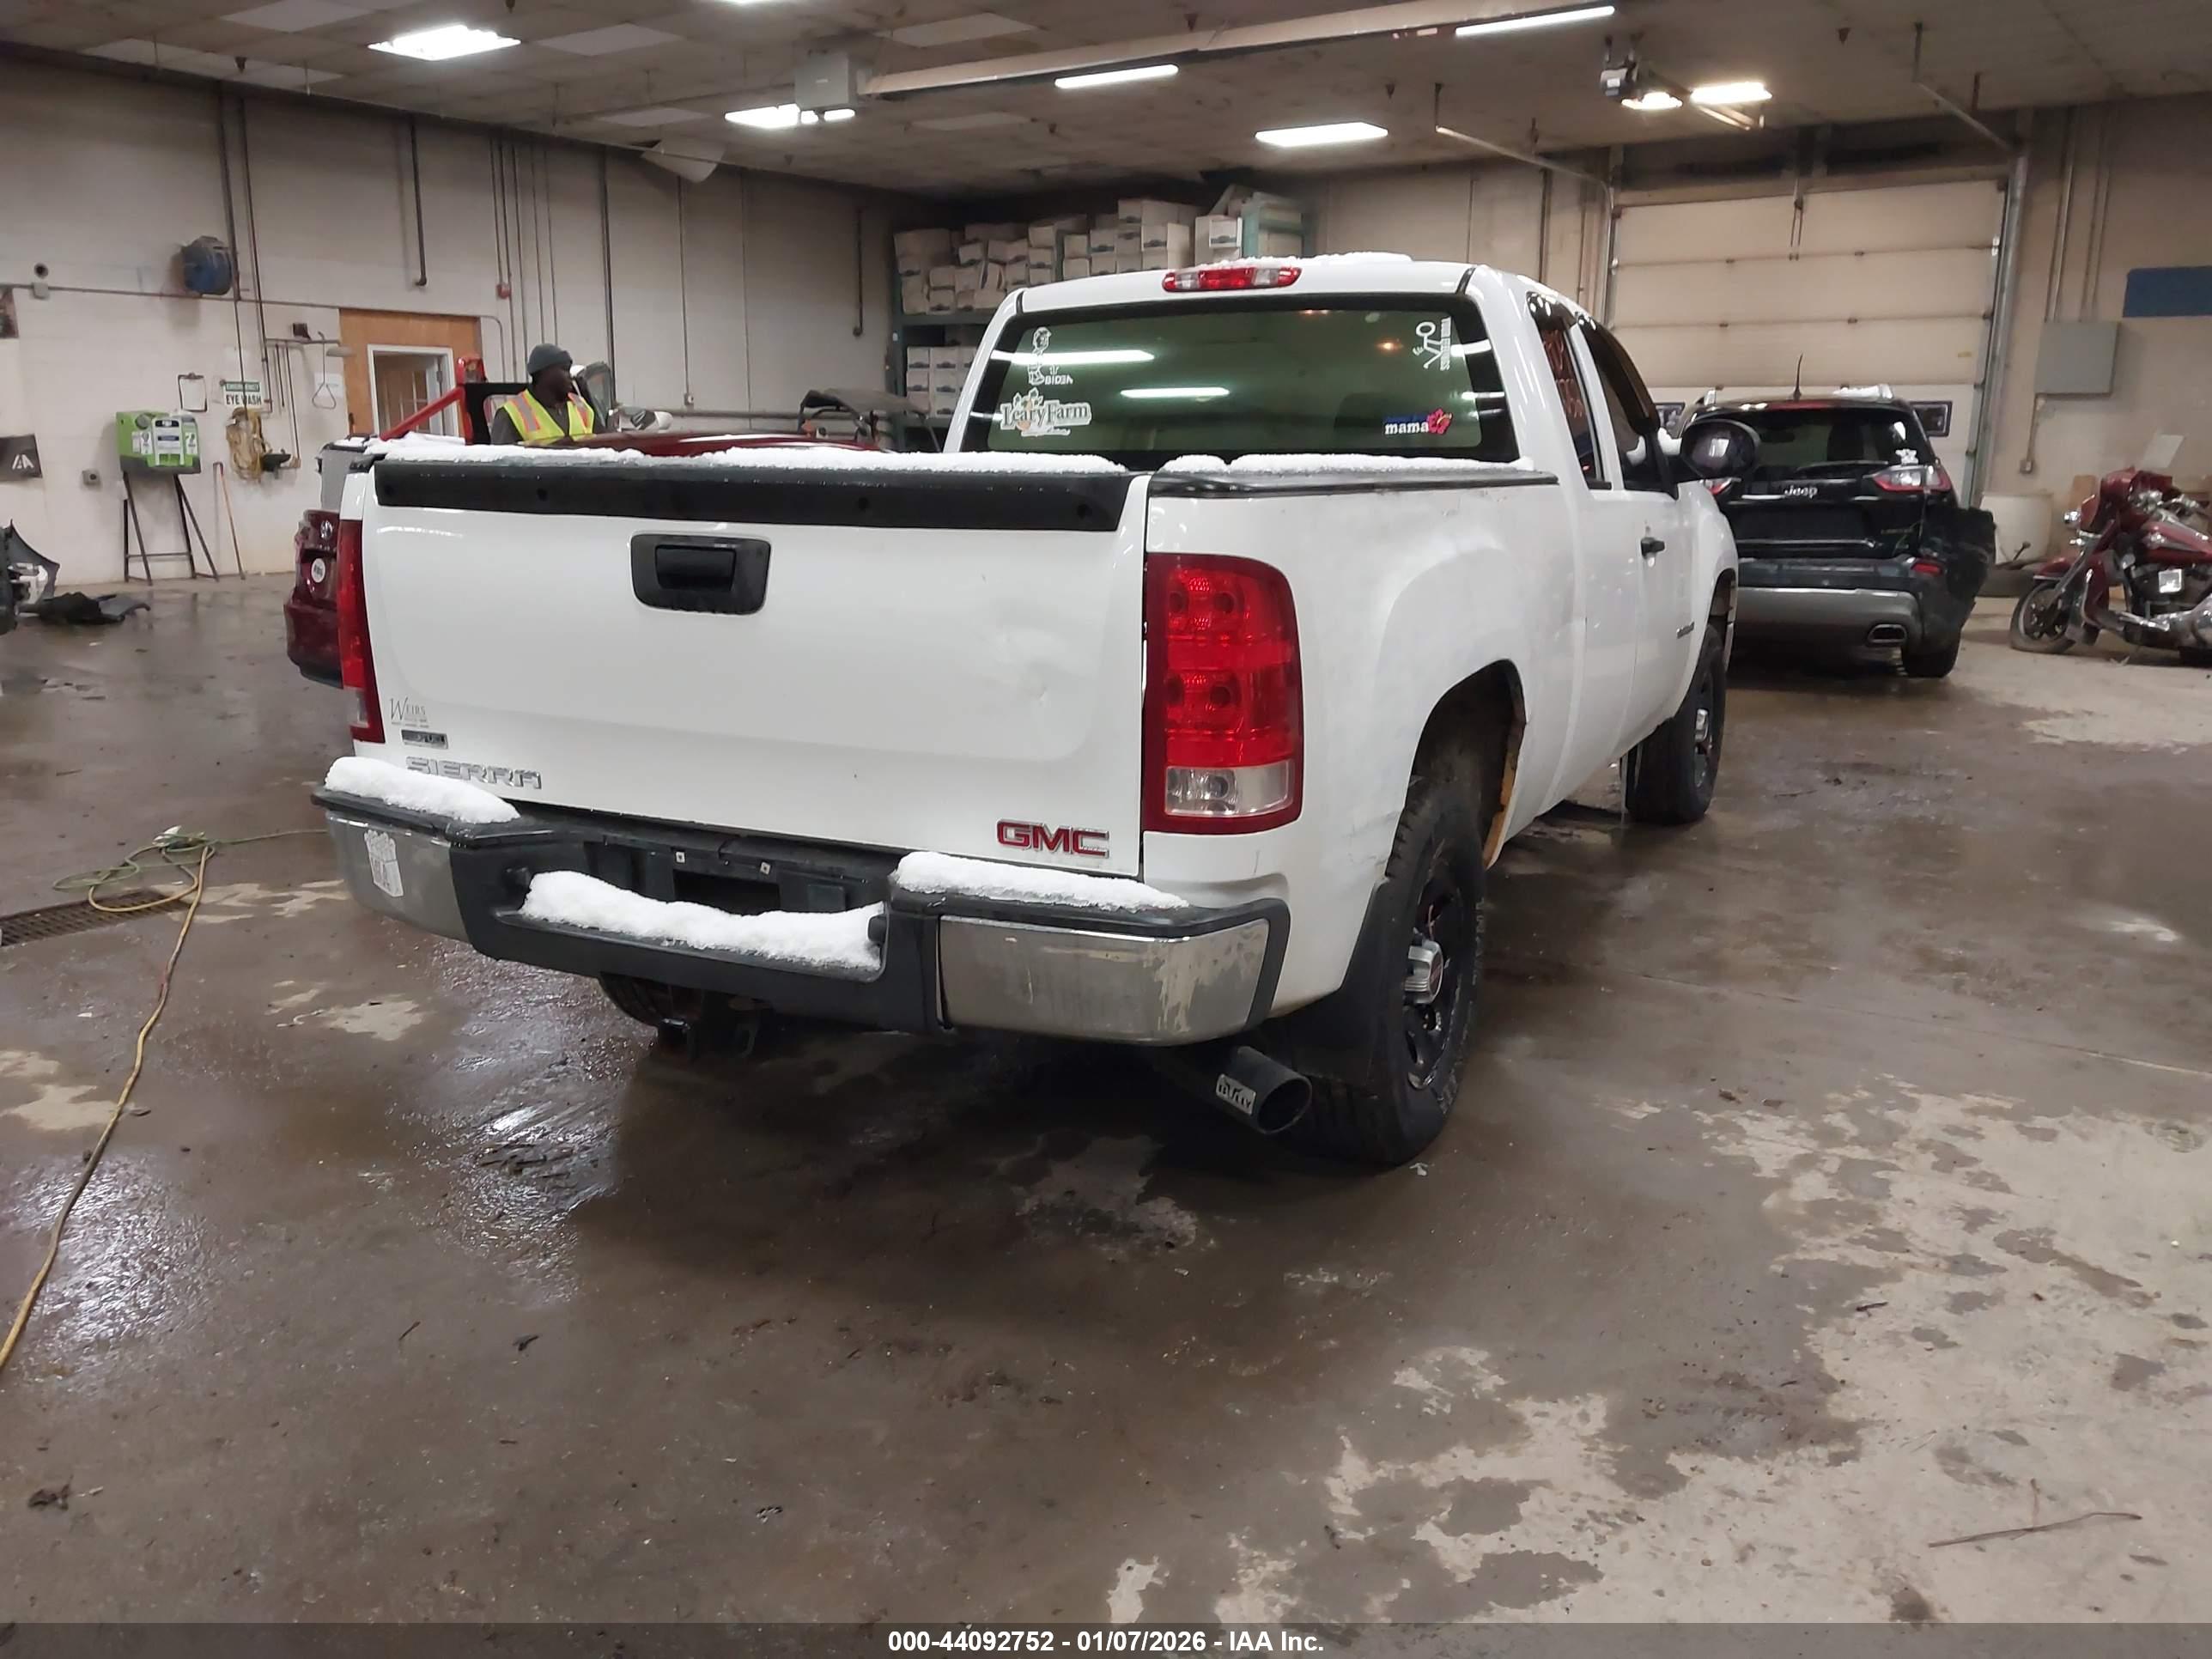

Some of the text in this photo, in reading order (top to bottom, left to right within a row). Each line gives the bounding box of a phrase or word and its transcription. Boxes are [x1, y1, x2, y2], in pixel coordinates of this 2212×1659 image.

[226, 394, 240, 405] EYE
[1385, 422, 1430, 434] mama
[1784, 484, 1819, 499] Jeep
[405, 756, 542, 789] SIERRA
[997, 818, 1109, 859] GMC
